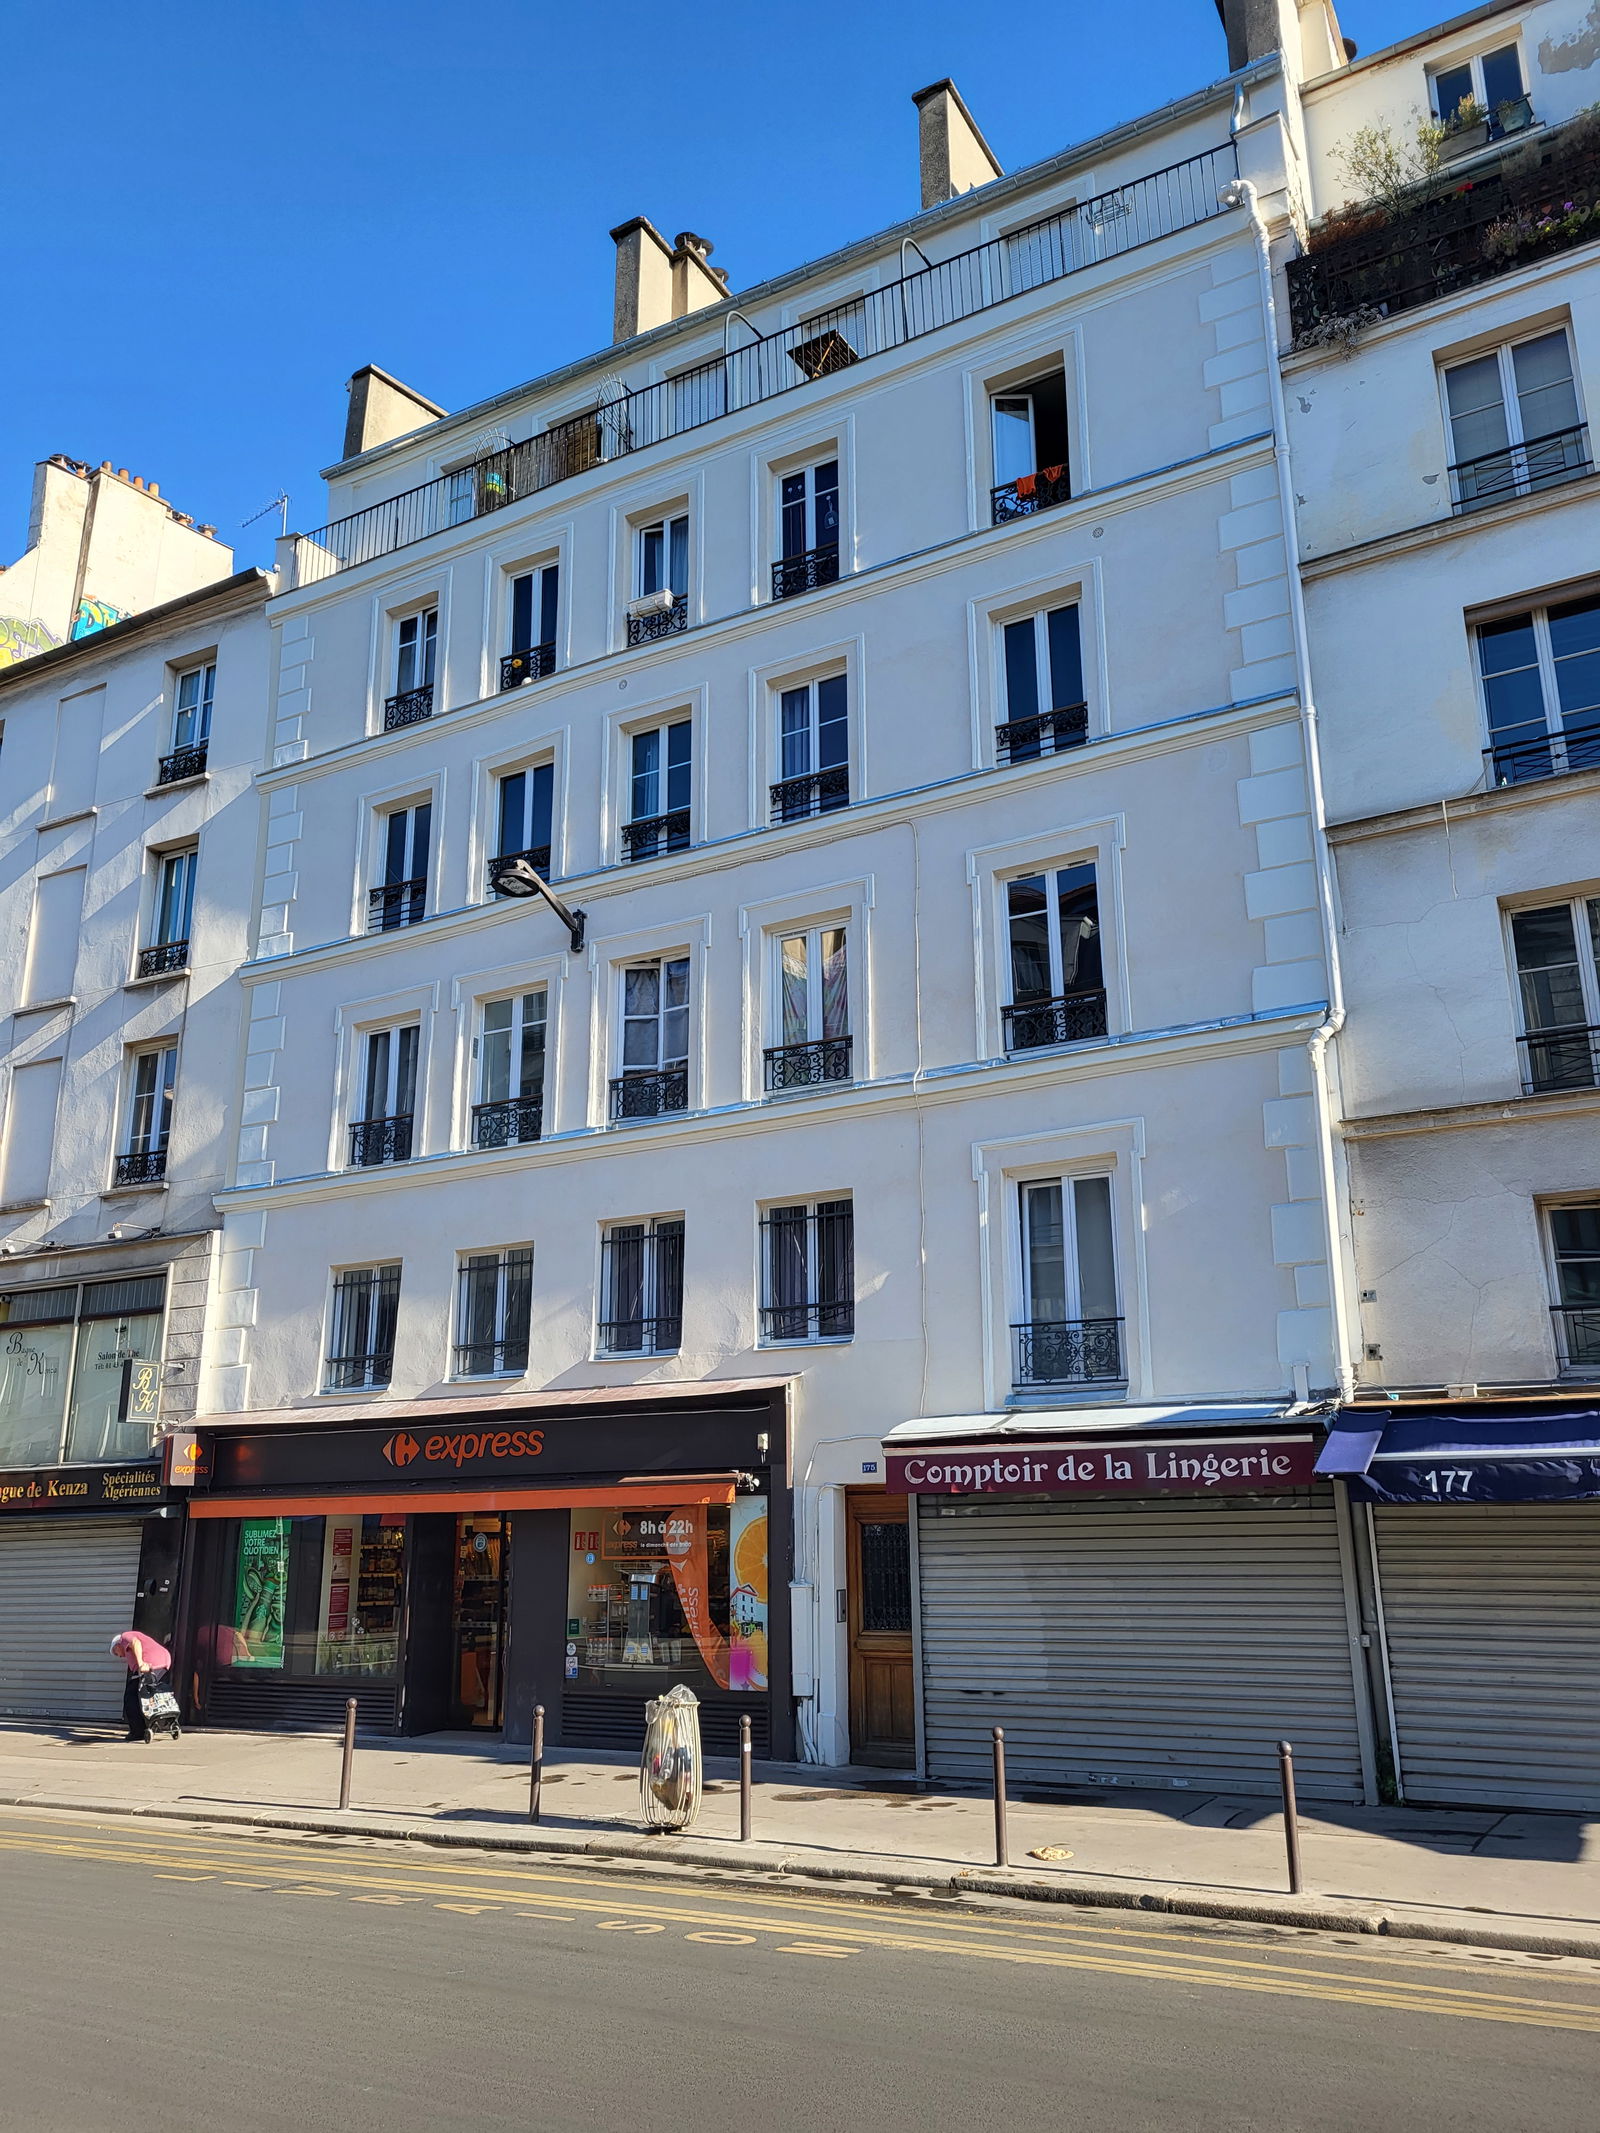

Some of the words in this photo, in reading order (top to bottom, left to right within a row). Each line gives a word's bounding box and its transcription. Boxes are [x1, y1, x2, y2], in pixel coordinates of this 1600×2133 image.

[98, 1351, 116, 1361] Salon
[117, 1349, 126, 1359] de
[132, 1367, 153, 1390] B
[424, 1430, 545, 1468] express
[174, 1465, 209, 1477] express
[863, 1464, 876, 1472] 175
[904, 1456, 1049, 1490] Comptoir
[1057, 1454, 1096, 1481] de
[1103, 1453, 1133, 1480] la
[1145, 1448, 1292, 1487] Lingerie
[102, 1470, 156, 1487] Spécialités
[1425, 1470, 1474, 1493] 177
[27, 1481, 42, 1498] de
[47, 1479, 89, 1497] Kenza
[101, 1484, 161, 1501] Algériennes
[244, 1530, 277, 1538] SUBLIMEZ
[640, 1520, 656, 1535] 8h
[658, 1520, 667, 1534] à
[669, 1519, 693, 1534] 22h
[243, 1546, 279, 1555] QUOTIDIEN
[244, 1538, 266, 1547] VOTRE
[153, 1874, 864, 1959] LIVRAISON
